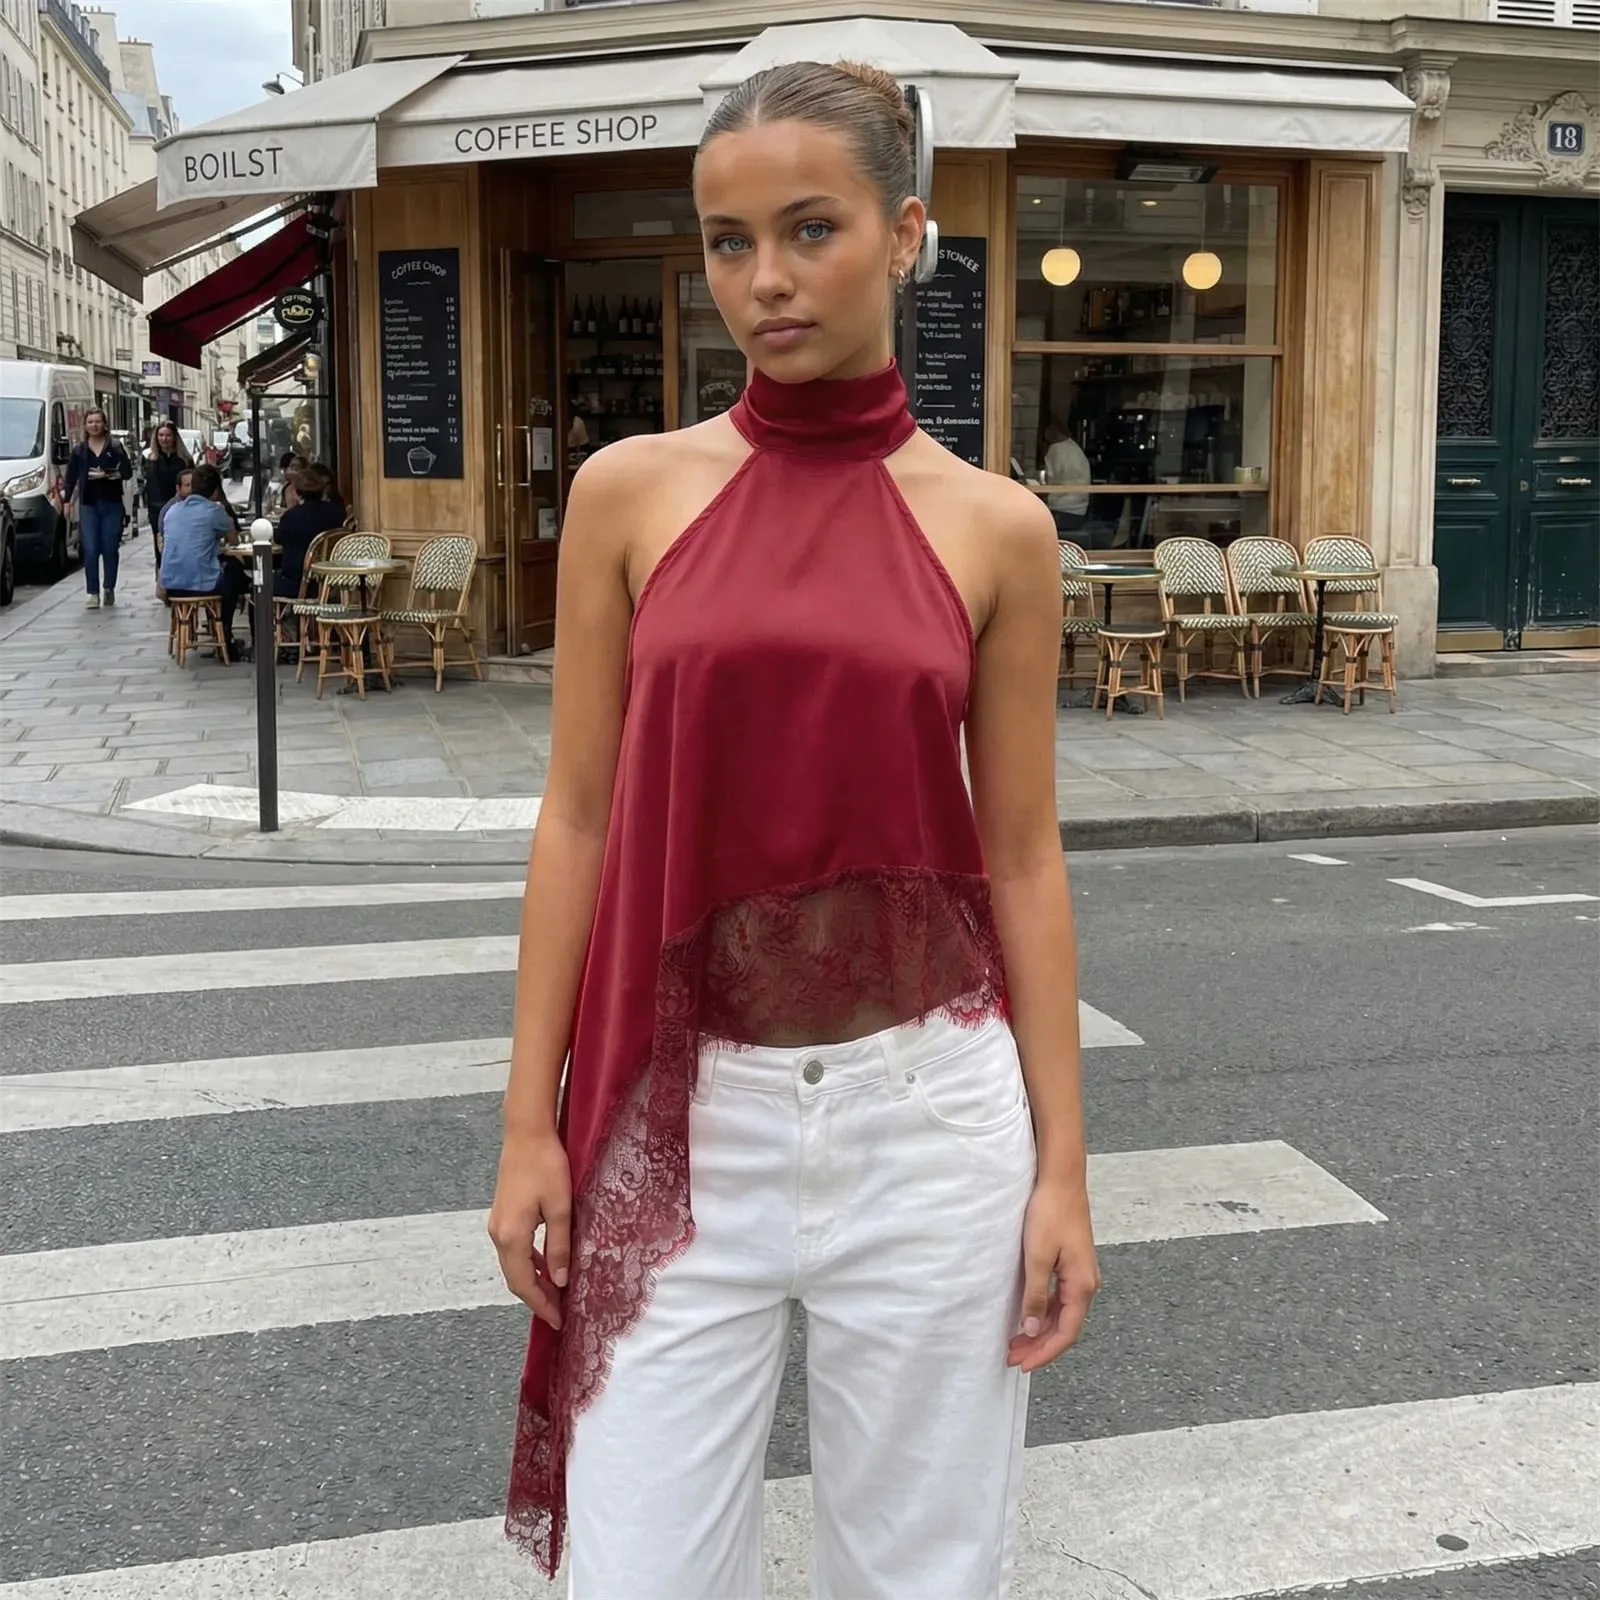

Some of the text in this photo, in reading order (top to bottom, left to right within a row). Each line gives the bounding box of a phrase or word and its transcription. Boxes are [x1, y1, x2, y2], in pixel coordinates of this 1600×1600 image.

[455, 114, 658, 153] COFFEE SHOP
[1554, 126, 1577, 149] 18
[185, 147, 283, 182] BOILST
